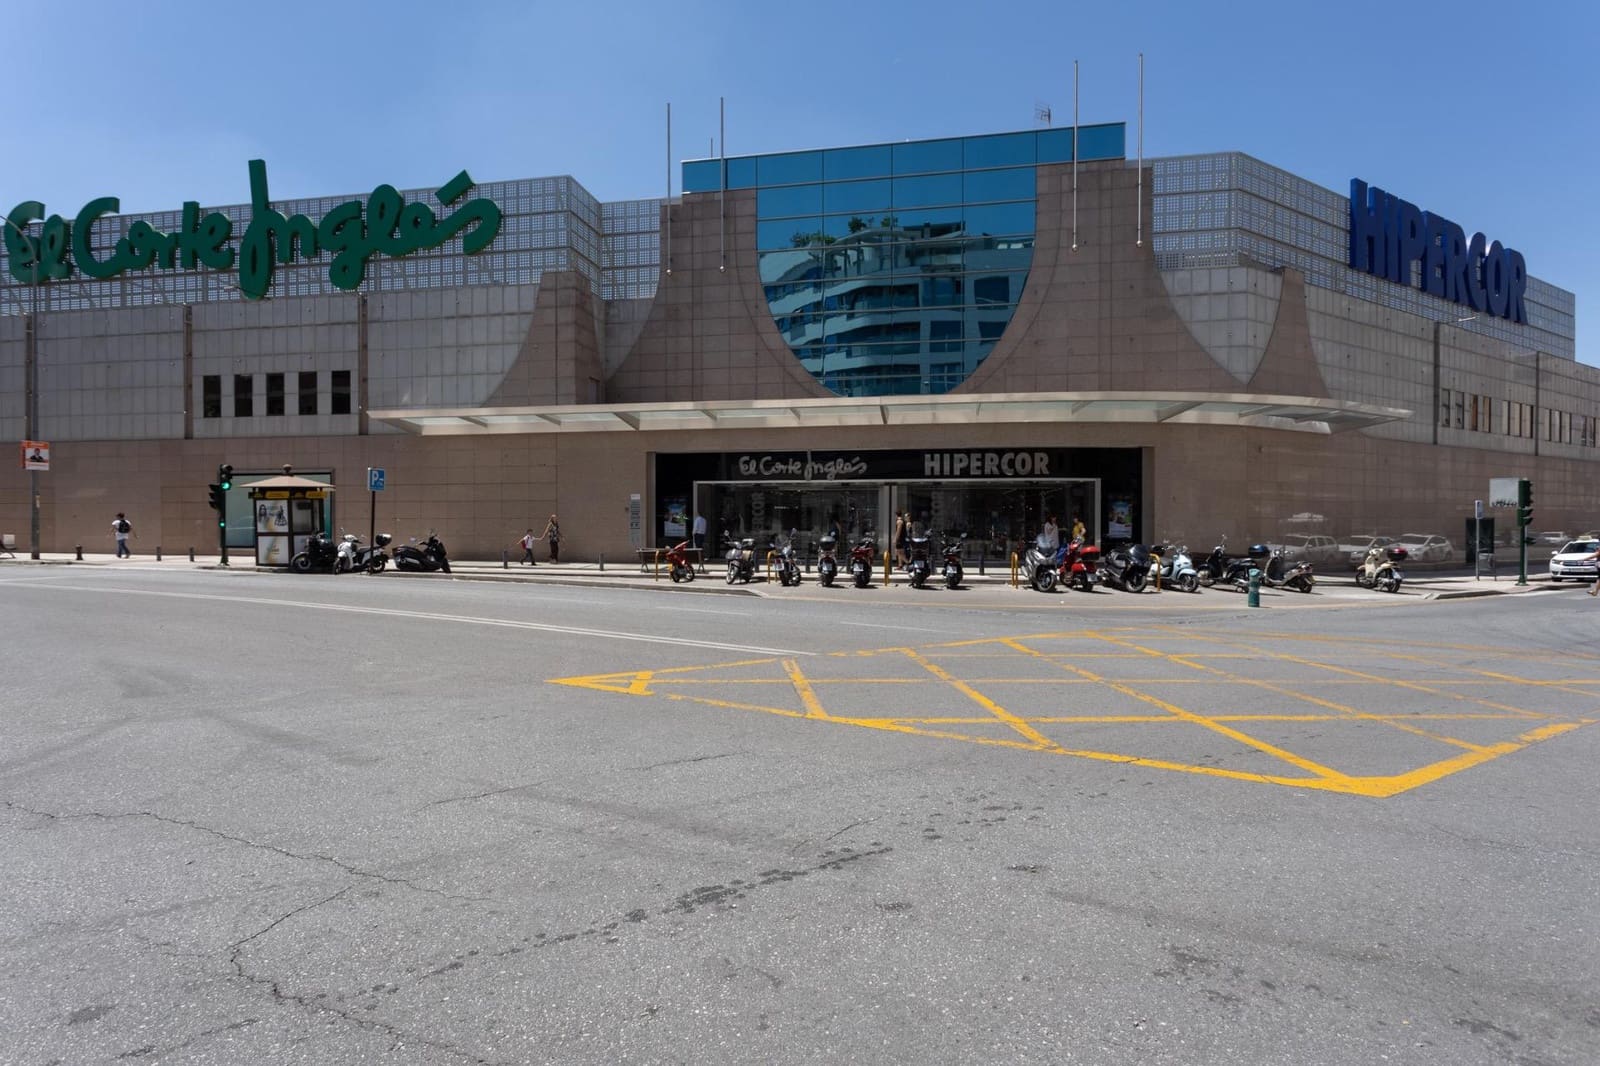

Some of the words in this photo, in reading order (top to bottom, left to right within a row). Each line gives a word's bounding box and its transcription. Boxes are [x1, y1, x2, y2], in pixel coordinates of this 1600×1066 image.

[4, 201, 73, 284] El
[72, 197, 235, 279] Corte
[239, 159, 501, 300] Inglés
[1349, 177, 1529, 326] HIPERCOR
[738, 456, 758, 476] El
[759, 456, 802, 476] Corte
[804, 451, 868, 481] Inglés
[924, 452, 1050, 476] HIPERCOR
